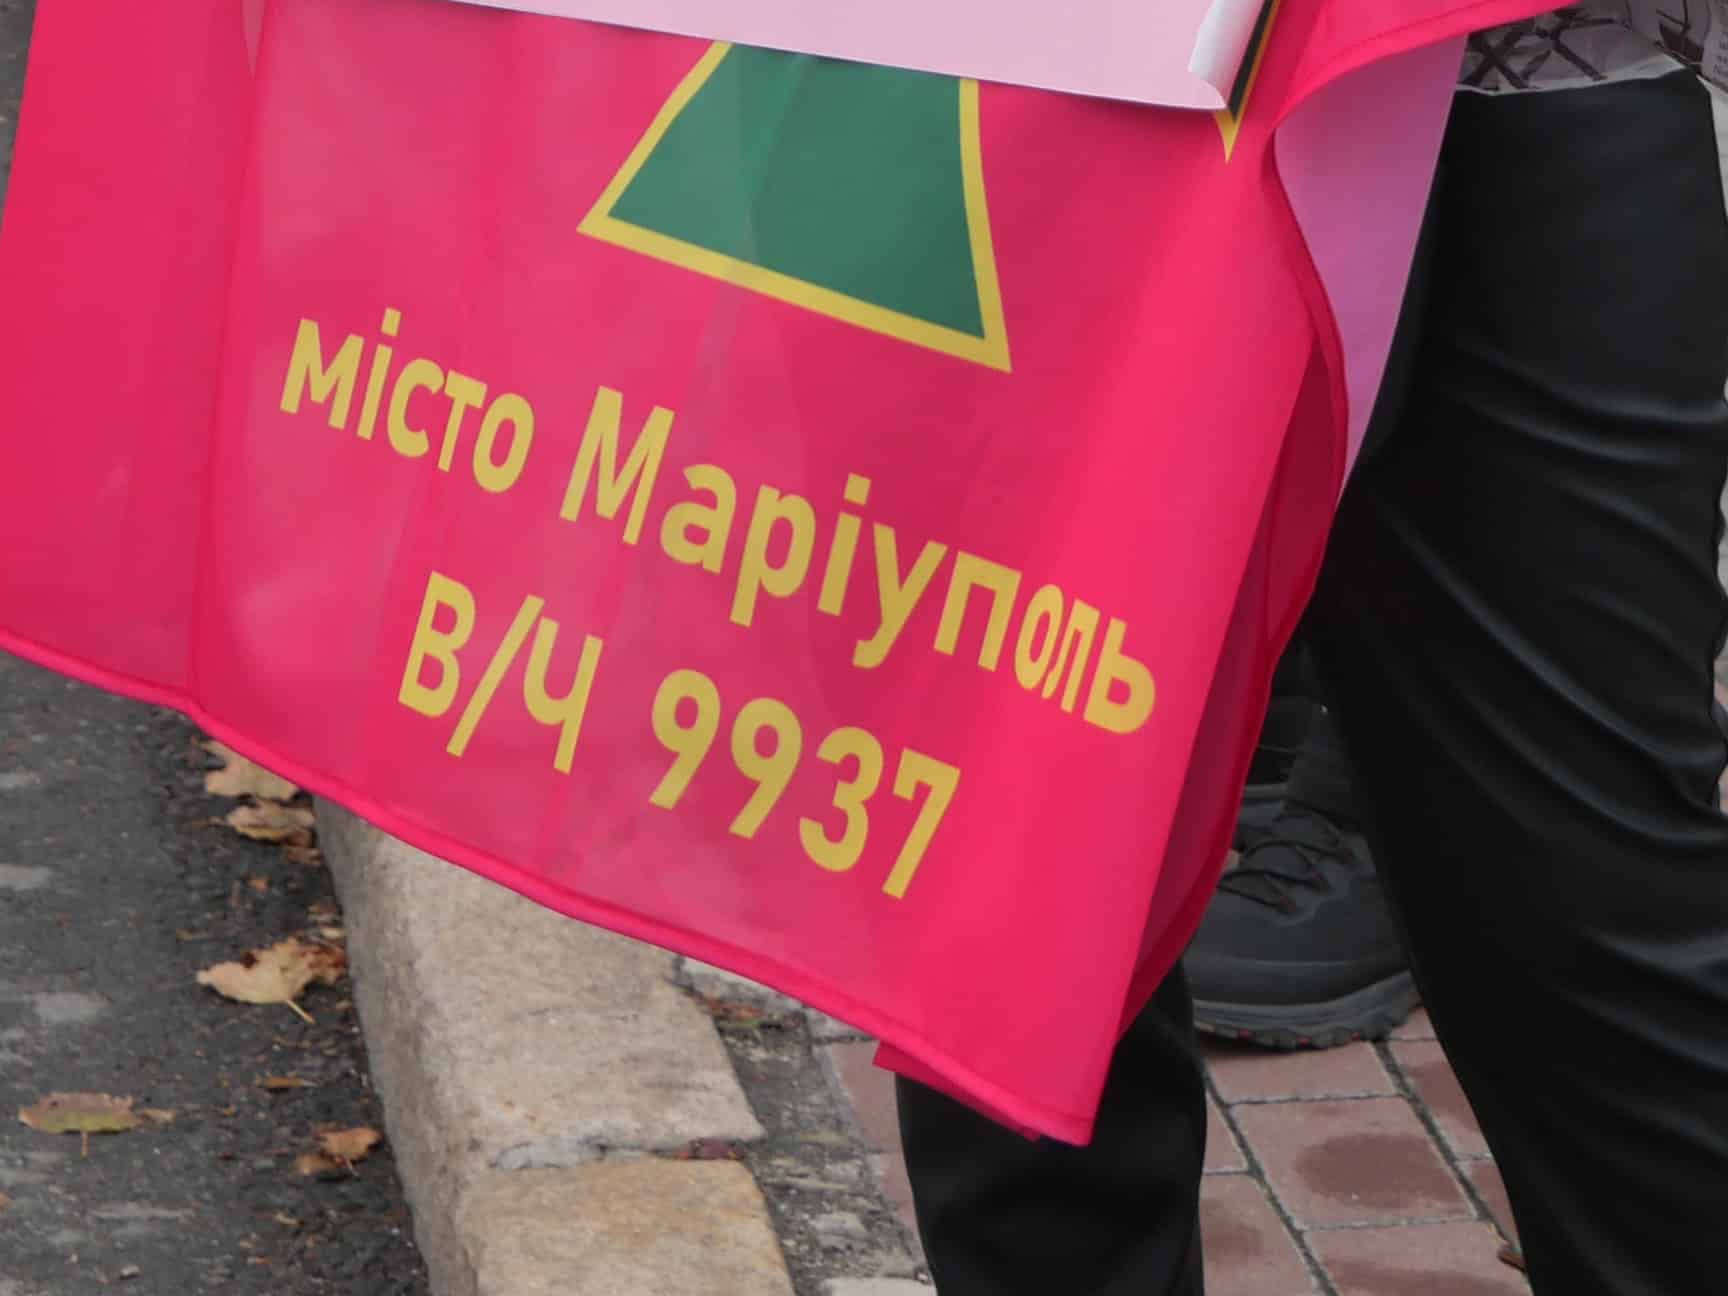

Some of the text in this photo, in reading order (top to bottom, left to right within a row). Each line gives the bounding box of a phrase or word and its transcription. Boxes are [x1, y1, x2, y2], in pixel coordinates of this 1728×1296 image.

[278, 308, 1158, 736] місто Маріуполь
[648, 667, 963, 902] 9937
